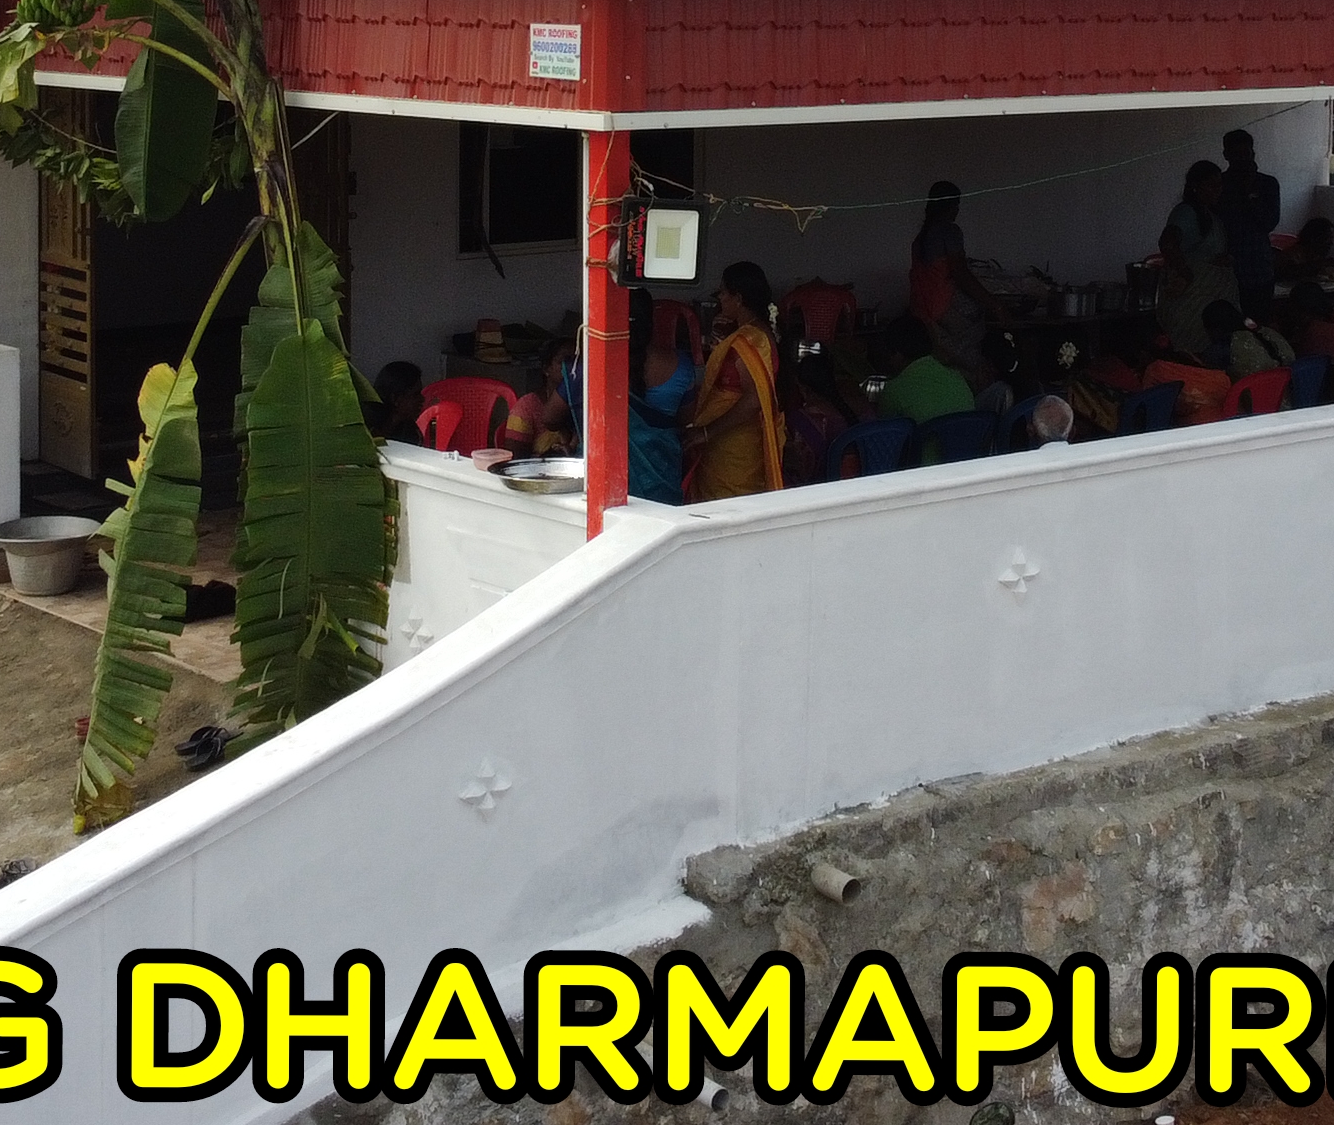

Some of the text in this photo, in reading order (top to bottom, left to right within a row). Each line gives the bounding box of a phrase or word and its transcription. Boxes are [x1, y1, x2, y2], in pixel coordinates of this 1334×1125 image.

[533, 28, 578, 40] KMC ROOFING
[539, 65, 551, 74] KMC
[552, 66, 577, 76] ROOFING
